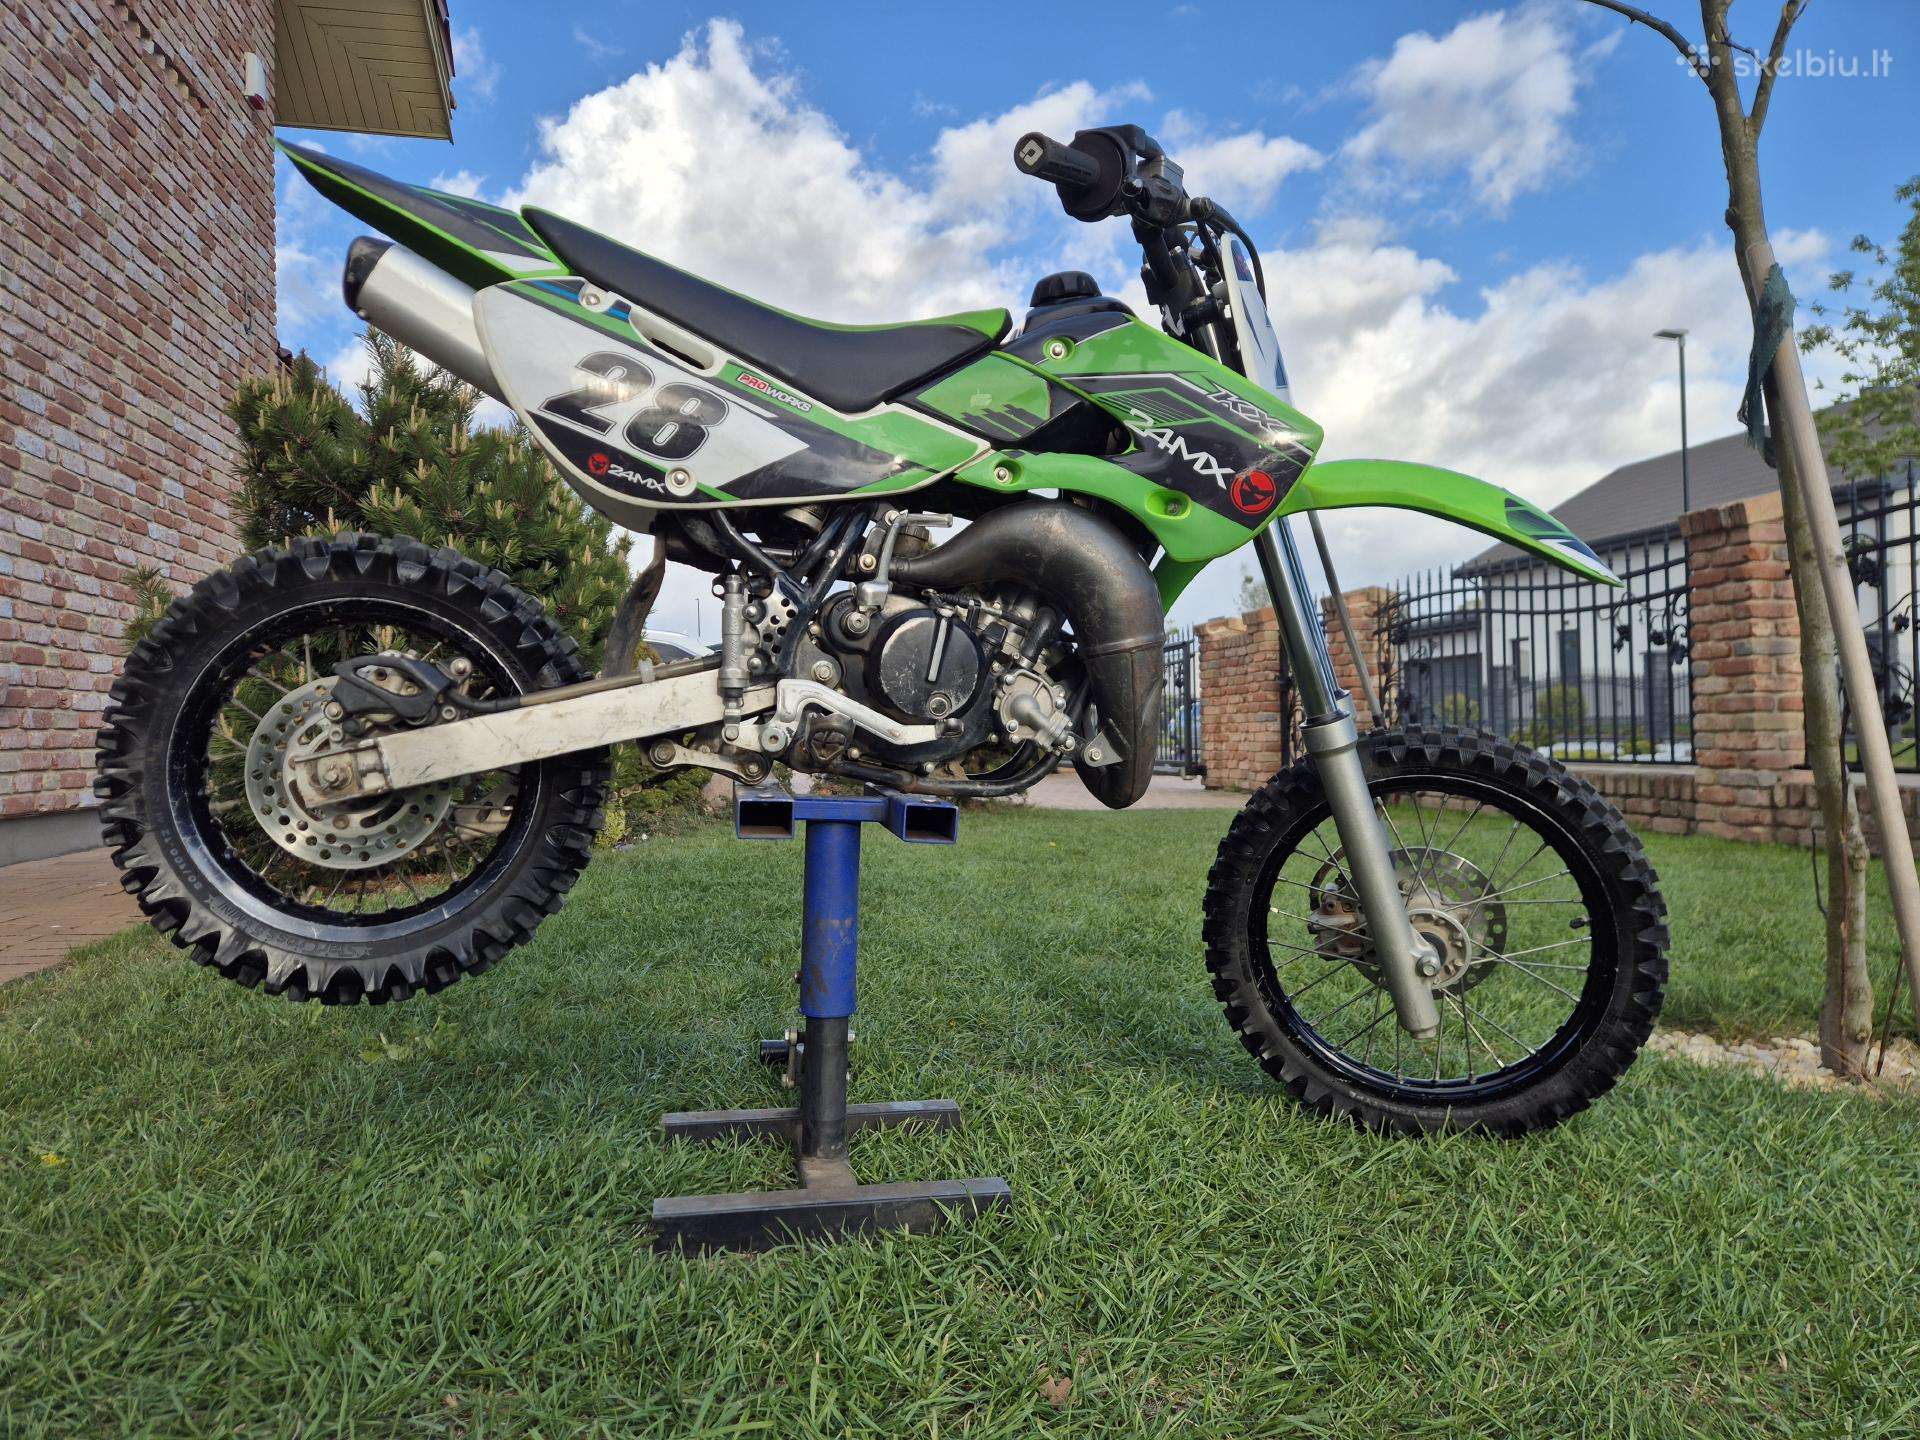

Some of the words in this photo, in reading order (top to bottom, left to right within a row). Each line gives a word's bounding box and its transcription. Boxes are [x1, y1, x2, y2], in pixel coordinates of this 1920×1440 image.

[538, 351, 729, 460] 28
[608, 463, 665, 494] 24MX
[1123, 407, 1236, 490] 24MX
